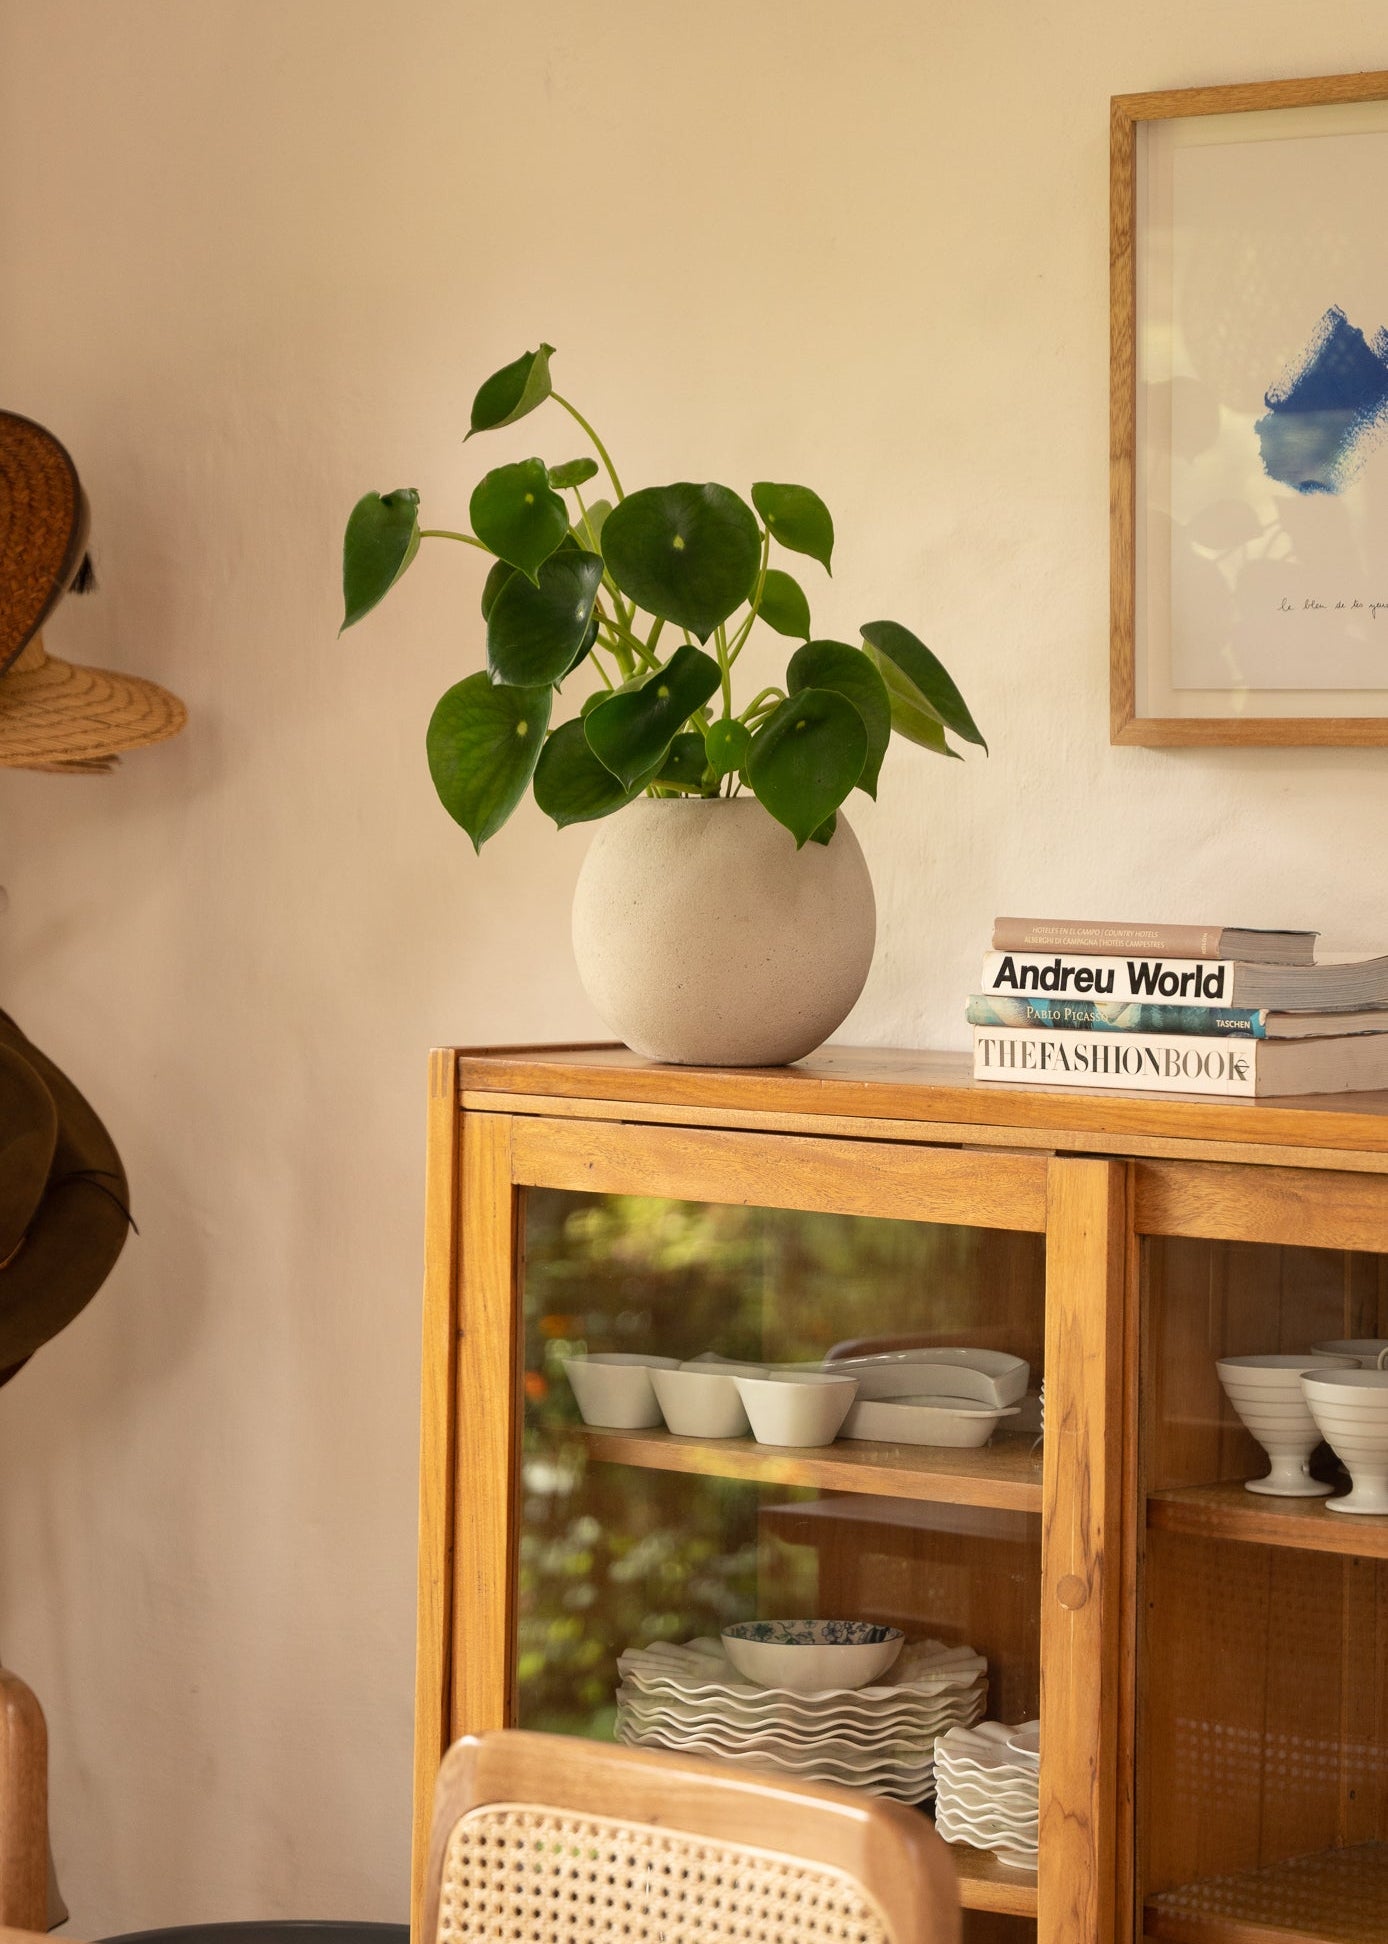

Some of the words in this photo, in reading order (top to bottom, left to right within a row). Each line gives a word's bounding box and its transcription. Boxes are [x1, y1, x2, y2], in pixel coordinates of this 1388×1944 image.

[1335, 600, 1346, 610] de
[1077, 928, 1101, 936] CAMPO
[1104, 929, 1135, 937] COUNTRY
[992, 956, 1115, 994] Andreu
[1126, 961, 1226, 999] World
[1026, 1006, 1061, 1021] PABLO
[1064, 1007, 1108, 1023] PICASSO
[1216, 1018, 1250, 1029] TASCHEN
